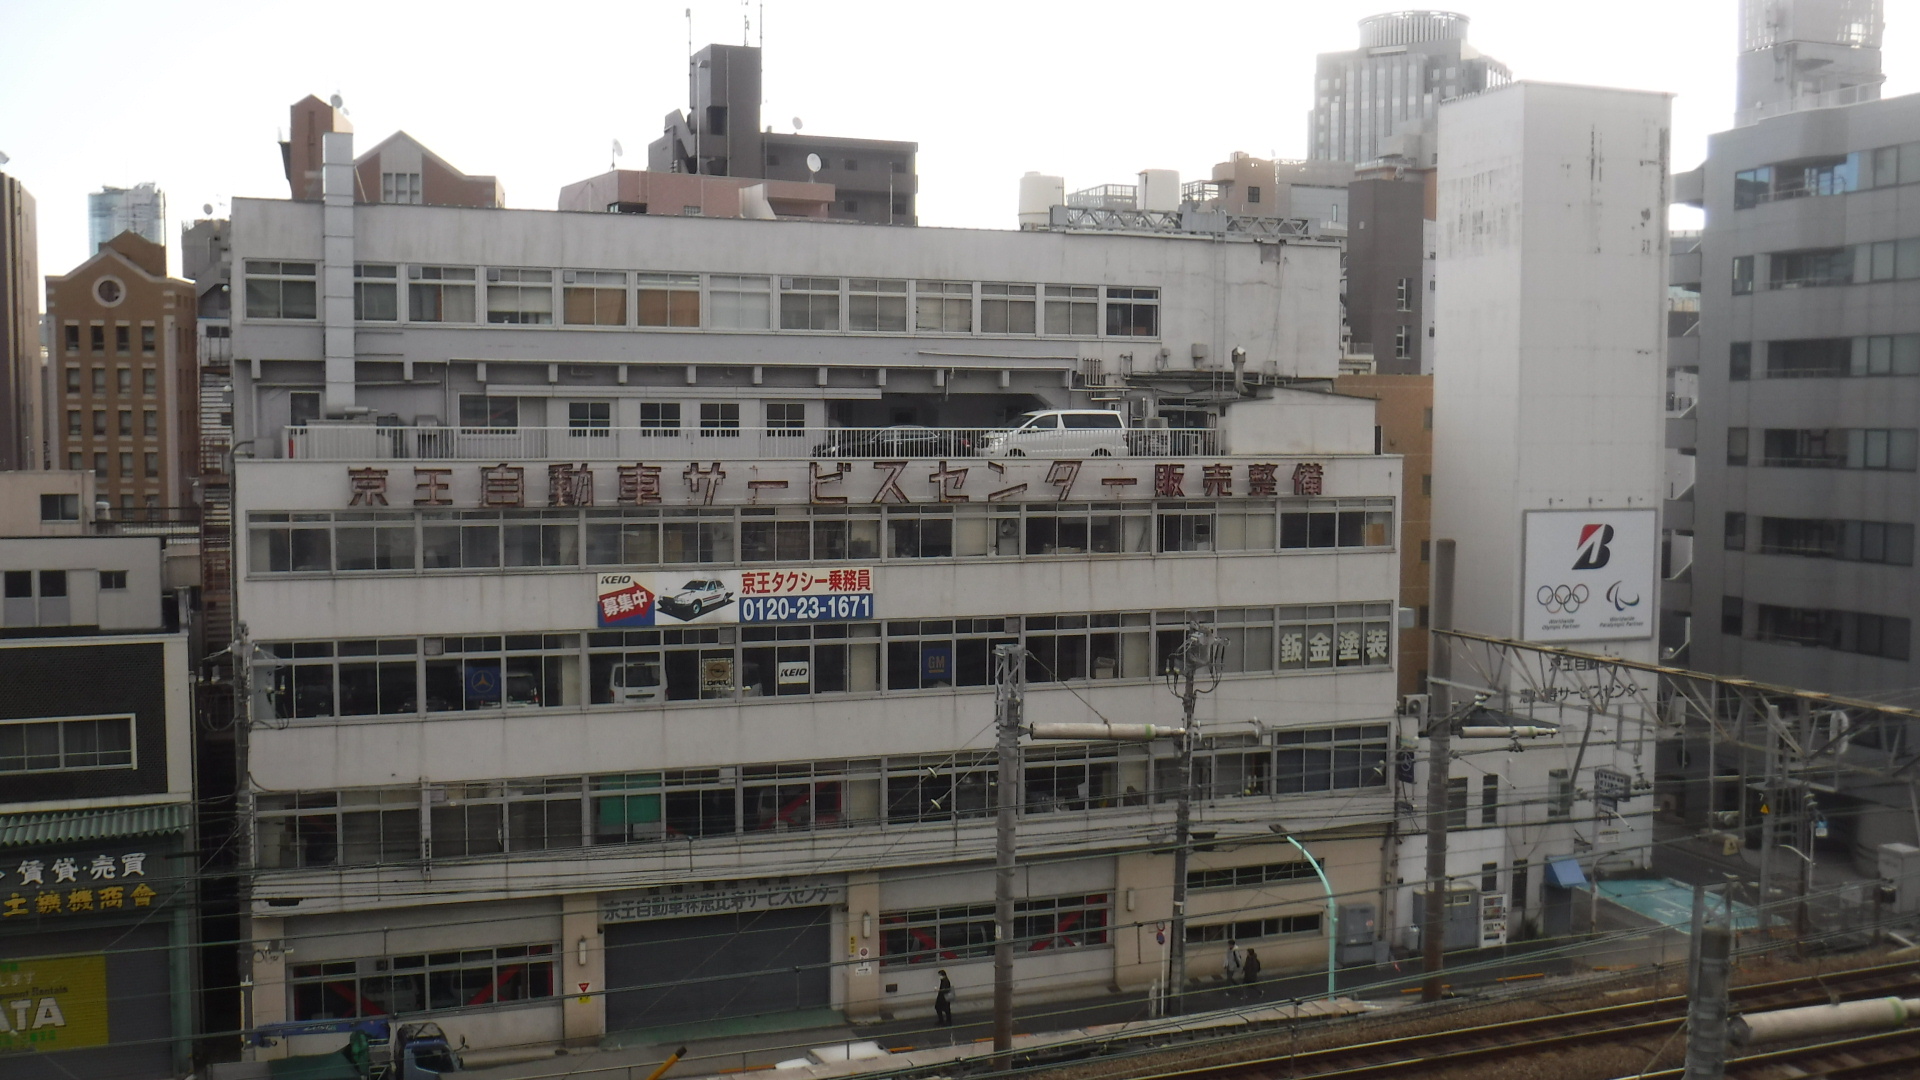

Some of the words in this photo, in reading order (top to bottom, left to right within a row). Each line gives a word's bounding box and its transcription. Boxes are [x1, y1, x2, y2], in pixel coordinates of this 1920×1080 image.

[601, 575, 631, 585] KEIO
[741, 569, 871, 594] 京王タクシー乗務員
[602, 590, 648, 617] 募集中
[743, 596, 870, 621] 0120-23-1671
[1281, 629, 1387, 662] 鈑金塗装
[780, 668, 807, 678] KEIO
[928, 656, 946, 669] GM
